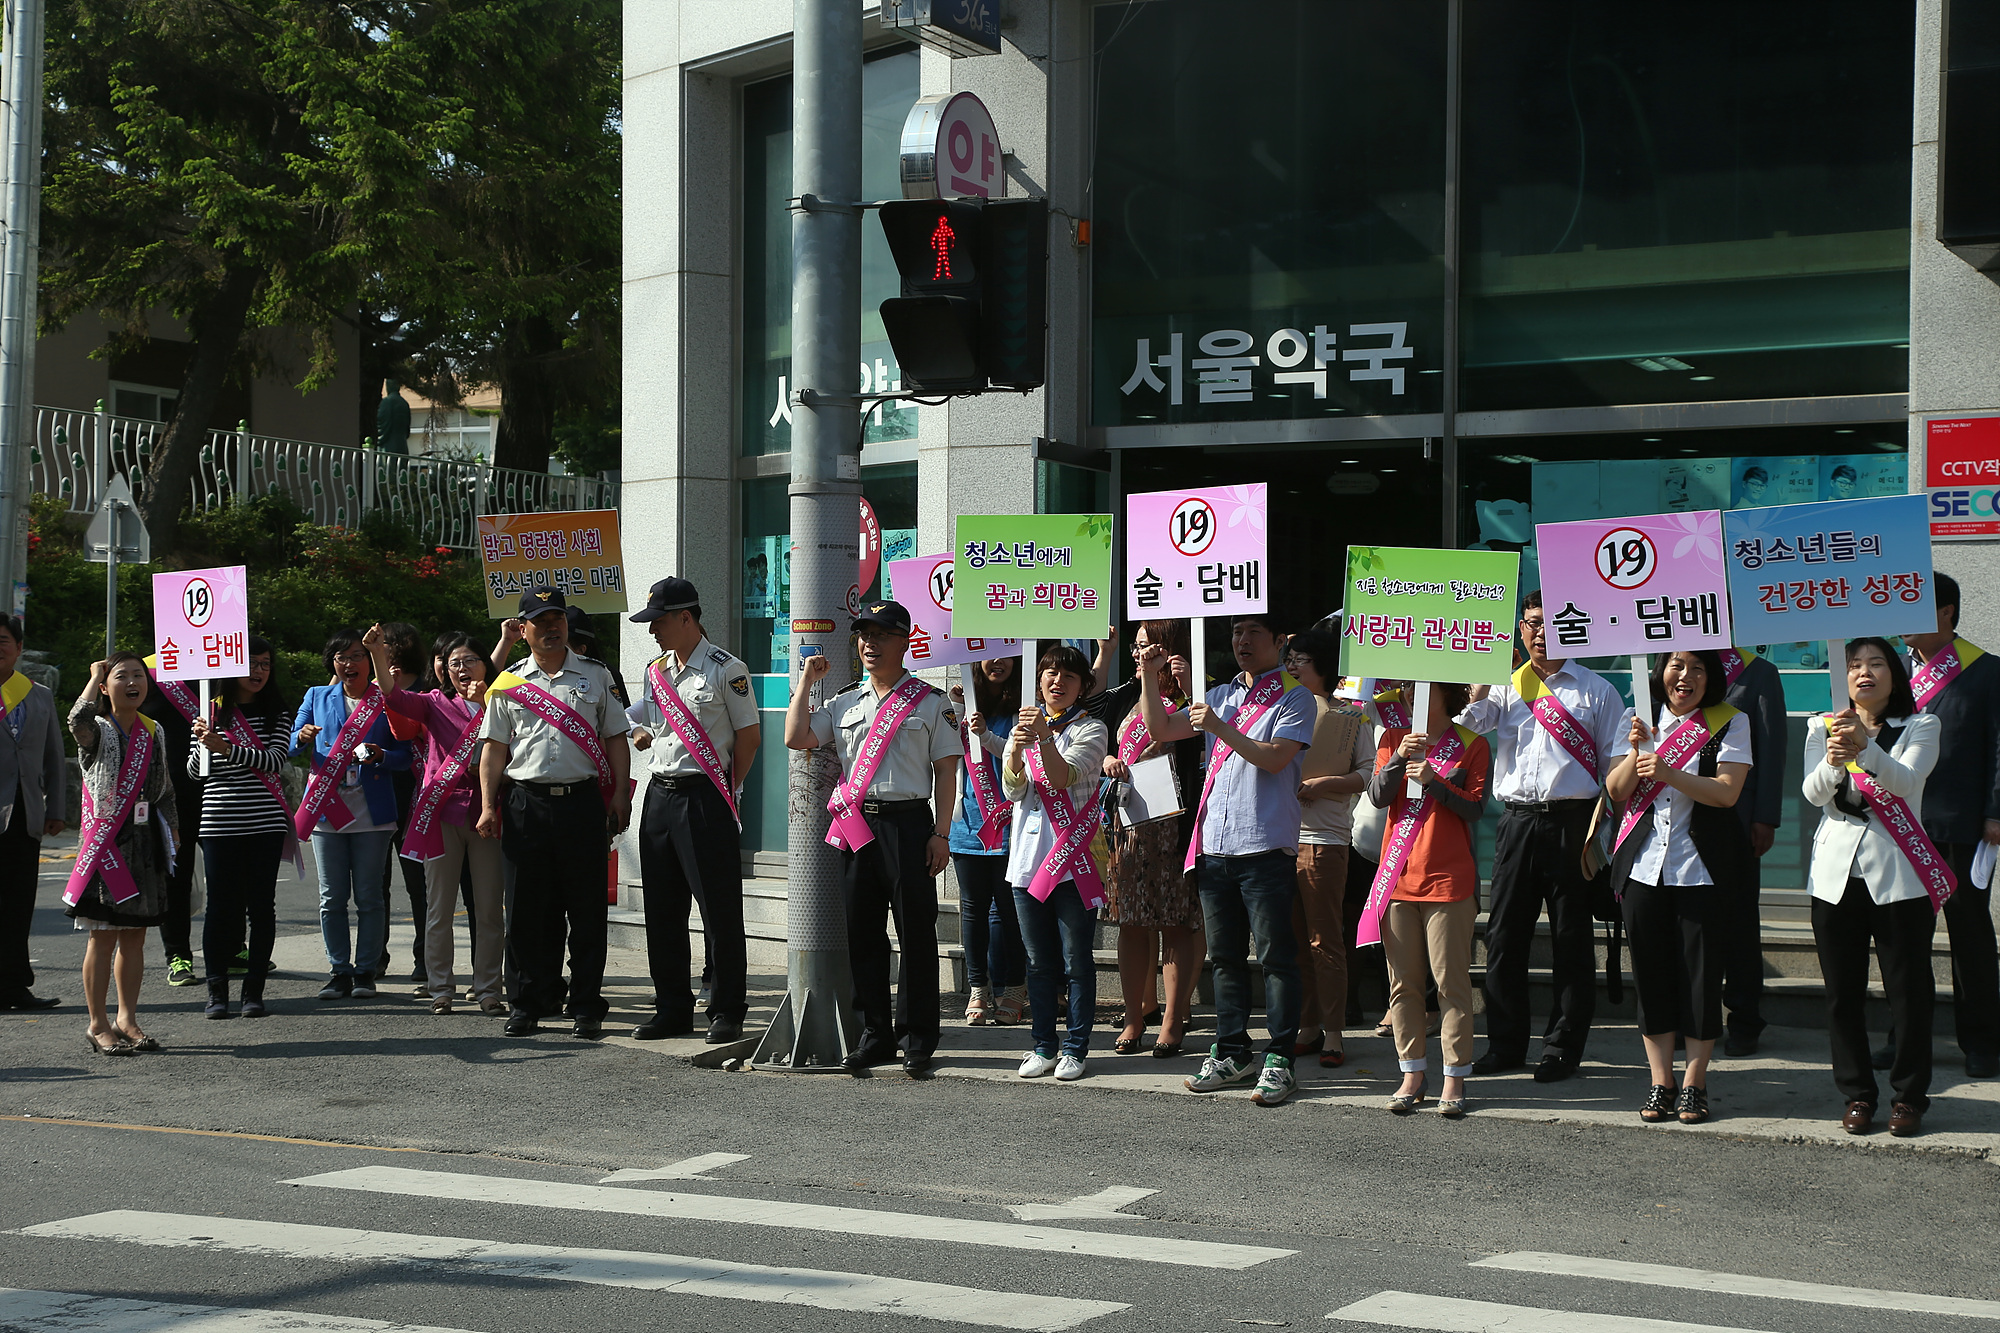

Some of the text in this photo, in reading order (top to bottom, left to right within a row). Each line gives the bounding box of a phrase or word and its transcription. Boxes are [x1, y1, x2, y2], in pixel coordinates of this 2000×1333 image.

[1120, 321, 1414, 405] 서울약국
[1175, 509, 1209, 544] 19
[482, 527, 603, 563] 밝고 명랑한 사회
[964, 542, 1071, 569] 청소년에게
[1602, 538, 1647, 578] 19
[1734, 530, 1881, 569] 청소년들의
[554, 567, 585, 597] 밝은
[588, 565, 622, 593] 미래
[984, 582, 1098, 610] 꿈과 희망을
[1133, 567, 1164, 608] 술
[1197, 559, 1260, 604] 담배
[1356, 577, 1506, 602] 지금 청소년에게 필요한건?
[1759, 571, 1924, 613] 건강한 성장
[186, 588, 211, 617] 19
[1551, 601, 1593, 647] 술
[1635, 591, 1721, 641] 담배
[793, 621, 832, 630] School Zone
[908, 625, 932, 660] 술
[1343, 614, 1511, 654] 사랑과 관심뿐~
[160, 636, 180, 670] 술
[203, 631, 244, 668] 담배
[1255, 679, 1281, 704] 청소년
[1907, 654, 1958, 701] 청소년 내일
[353, 706, 372, 727] 내일의
[516, 682, 542, 704] 청소년
[539, 699, 565, 720] 내일의
[1232, 701, 1258, 729] 내일의
[1536, 698, 1560, 724] 청소년
[1556, 720, 1583, 747] 내일의
[1435, 738, 1460, 764] 청소년이
[1659, 723, 1705, 769] 청소년이 건강
[326, 753, 344, 776] 우리의
[853, 765, 868, 787] 있도록
[1053, 801, 1071, 828] 우리의
[1864, 772, 1892, 805] 청소년
[1885, 804, 1913, 835] 내일의
[1930, 868, 1950, 897] 우리의
[1045, 843, 1073, 875] 보호합니다
[1386, 846, 1401, 870] 있도록
